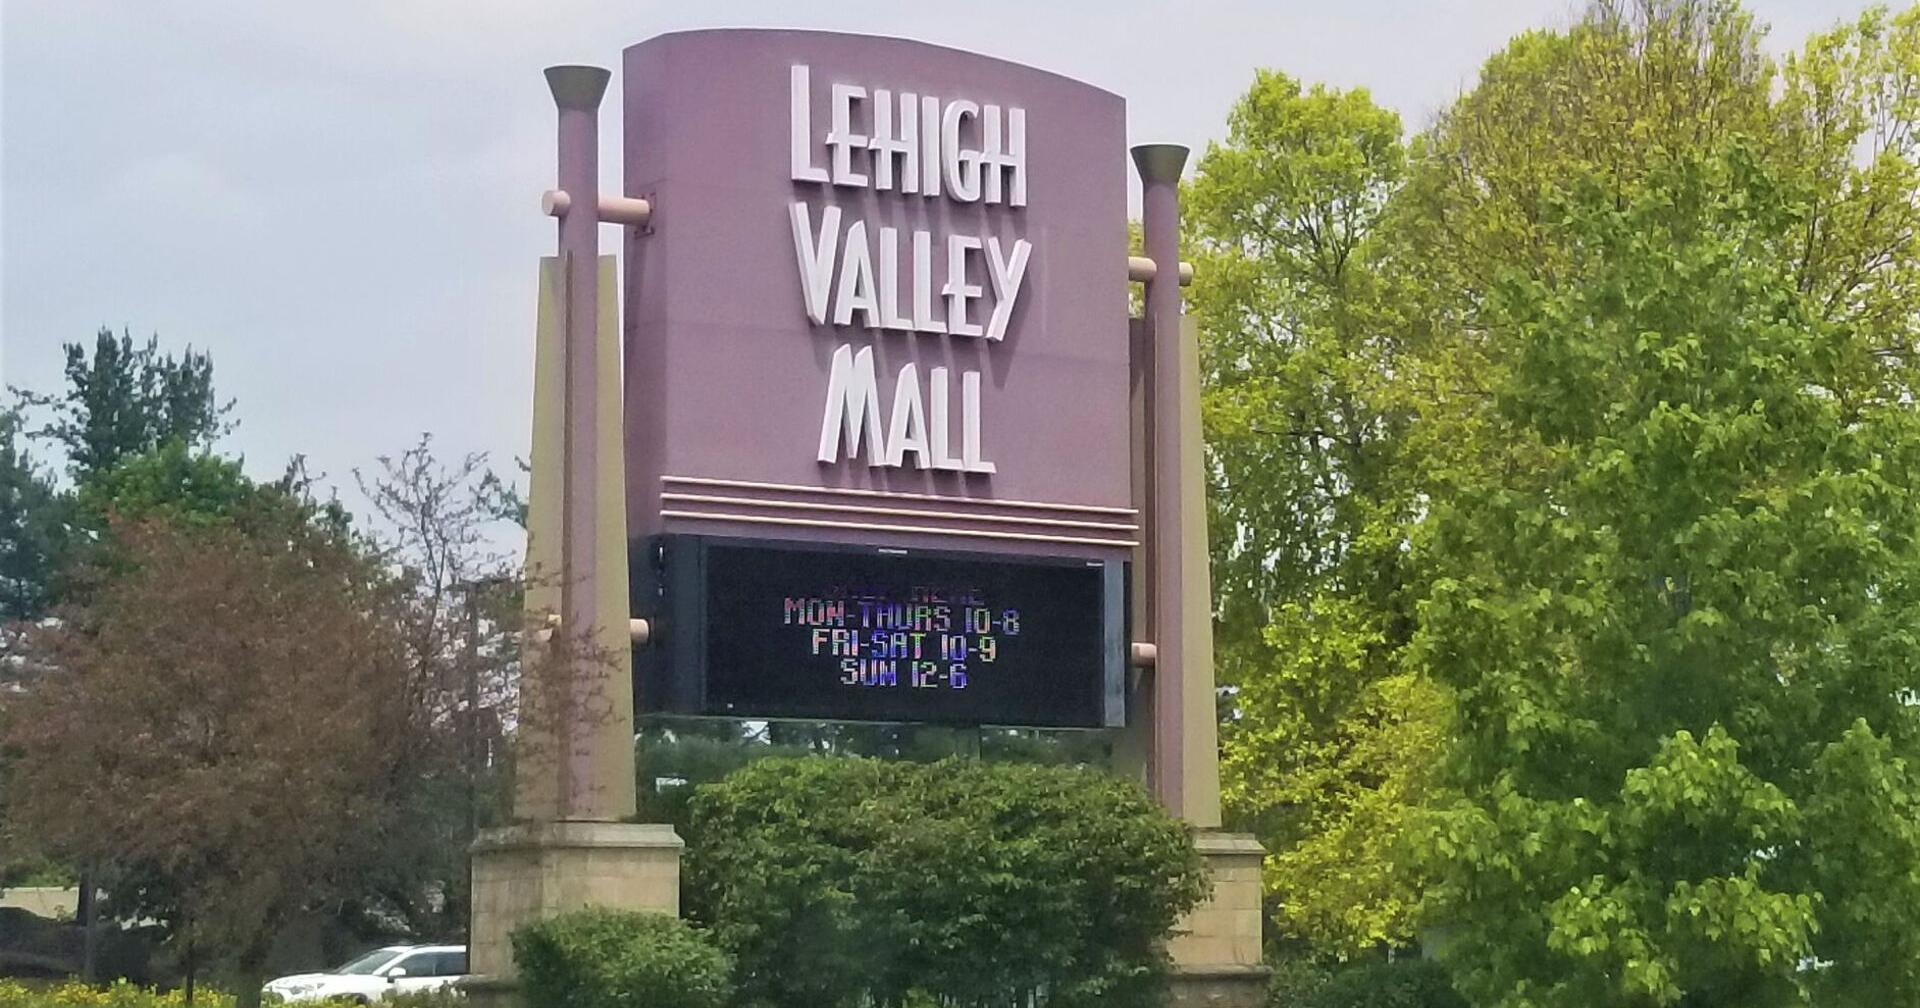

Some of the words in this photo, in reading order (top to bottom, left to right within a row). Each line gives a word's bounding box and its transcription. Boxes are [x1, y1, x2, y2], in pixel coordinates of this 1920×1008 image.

[790, 64, 1027, 207] LEHIGH
[789, 202, 1032, 341] VALLEY
[817, 343, 996, 474] MALL
[784, 597, 951, 632] MON-THURS
[965, 607, 1020, 635] 10-8
[812, 628, 927, 660] FRI-SAT
[941, 633, 997, 662] 10-9
[840, 658, 897, 687] SUN
[911, 660, 967, 689] 12-6
